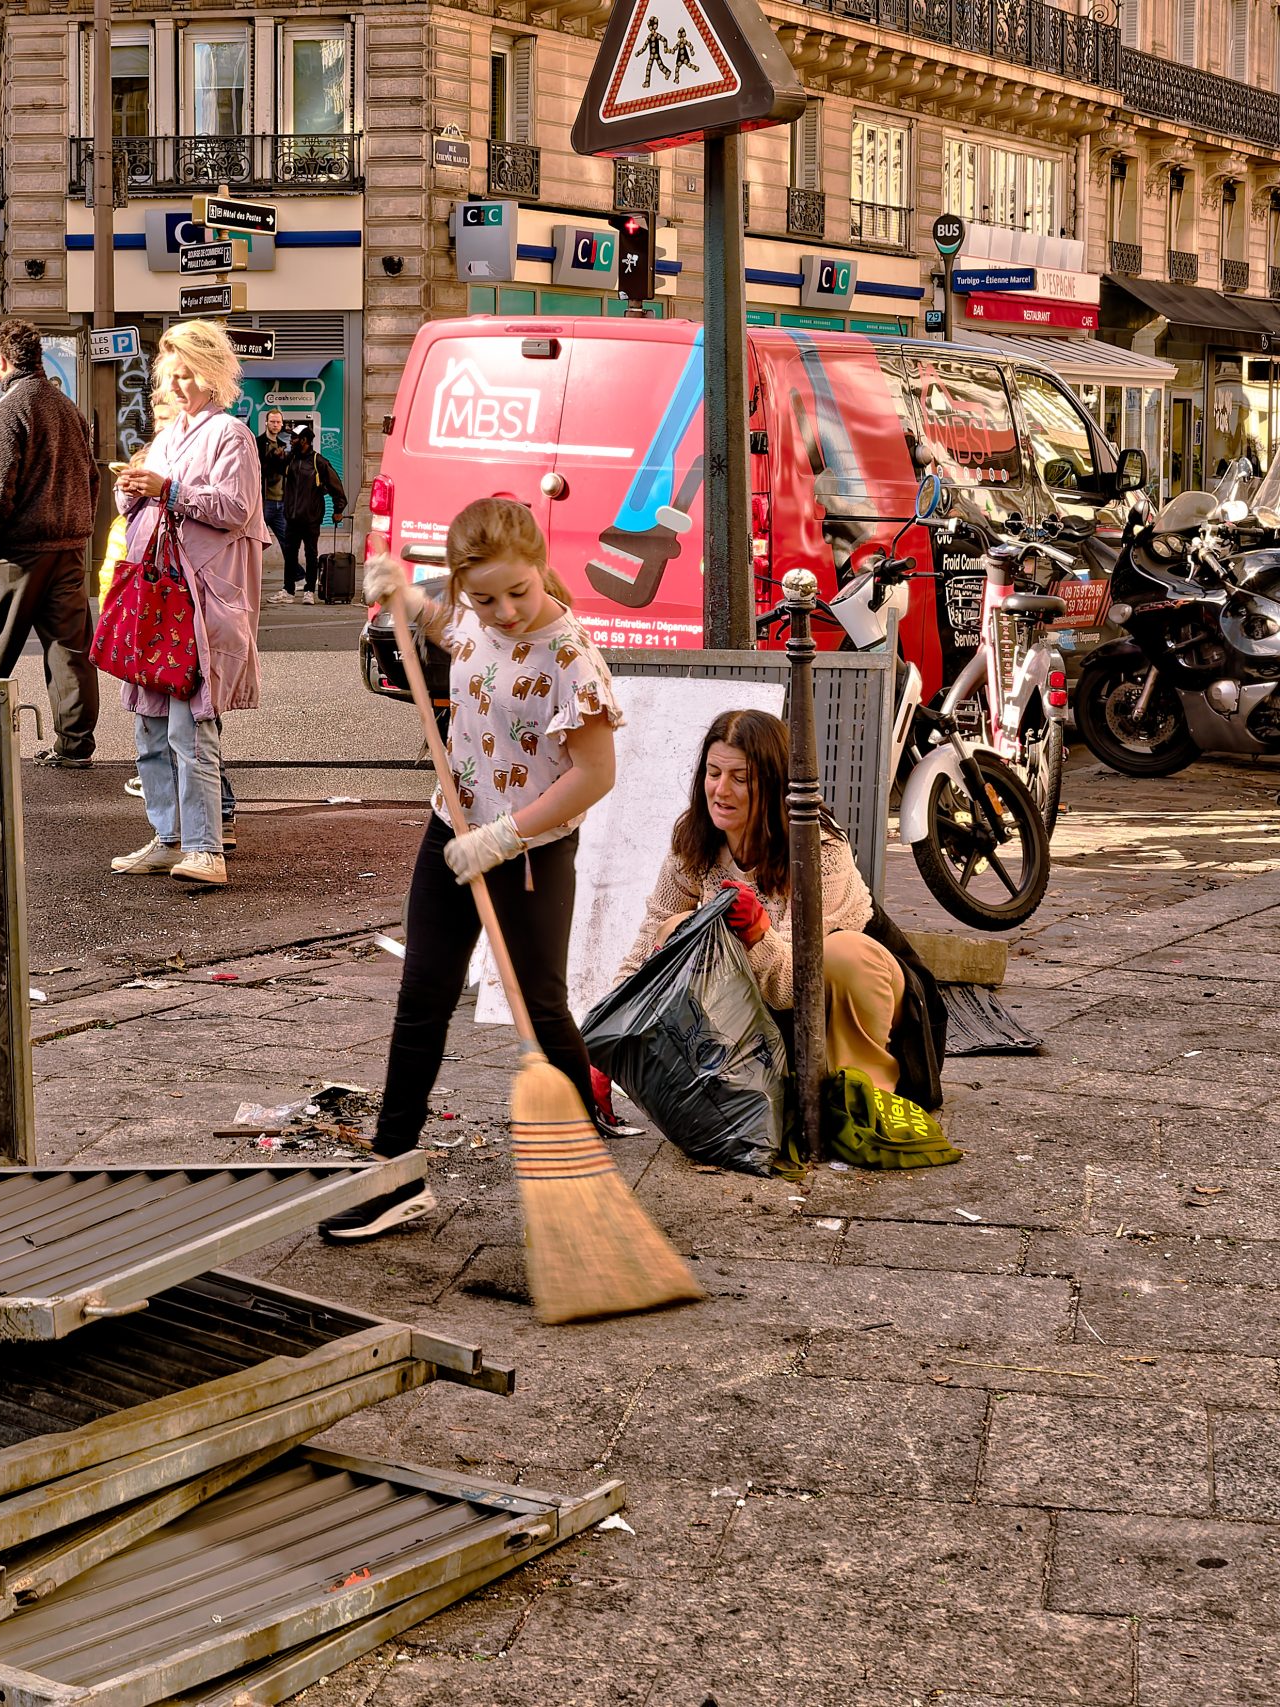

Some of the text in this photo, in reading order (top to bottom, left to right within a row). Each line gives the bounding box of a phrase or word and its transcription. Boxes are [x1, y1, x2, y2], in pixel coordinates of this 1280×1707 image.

[237, 211, 245, 220] des
[467, 209, 499, 223] CIC
[937, 223, 960, 237] BUS
[577, 238, 611, 265] CIC
[822, 266, 848, 289] CIC
[956, 276, 980, 286] Turbigo
[985, 274, 1009, 284] Étienne
[1010, 275, 1031, 284] Marcel
[1042, 273, 1076, 298] D'ESPAGNE
[928, 312, 940, 322] 29
[973, 304, 984, 316] BAR
[1023, 309, 1051, 322] RESTAURANT
[248, 345, 263, 354] PEUR
[441, 398, 524, 438] MBS
[933, 415, 985, 465] MBS
[432, 523, 450, 532] Comm
[936, 528, 952, 544] CVC
[943, 553, 982, 571] Froid Comm
[1065, 586, 1073, 598] 09
[1073, 586, 1080, 598] 75
[1068, 600, 1076, 612] 59
[1084, 599, 1091, 611] 21
[615, 619, 651, 630] Entretien
[656, 620, 703, 634] Dépannage
[593, 631, 677, 646] 06 59 78 21 11
[954, 631, 979, 647] Service
